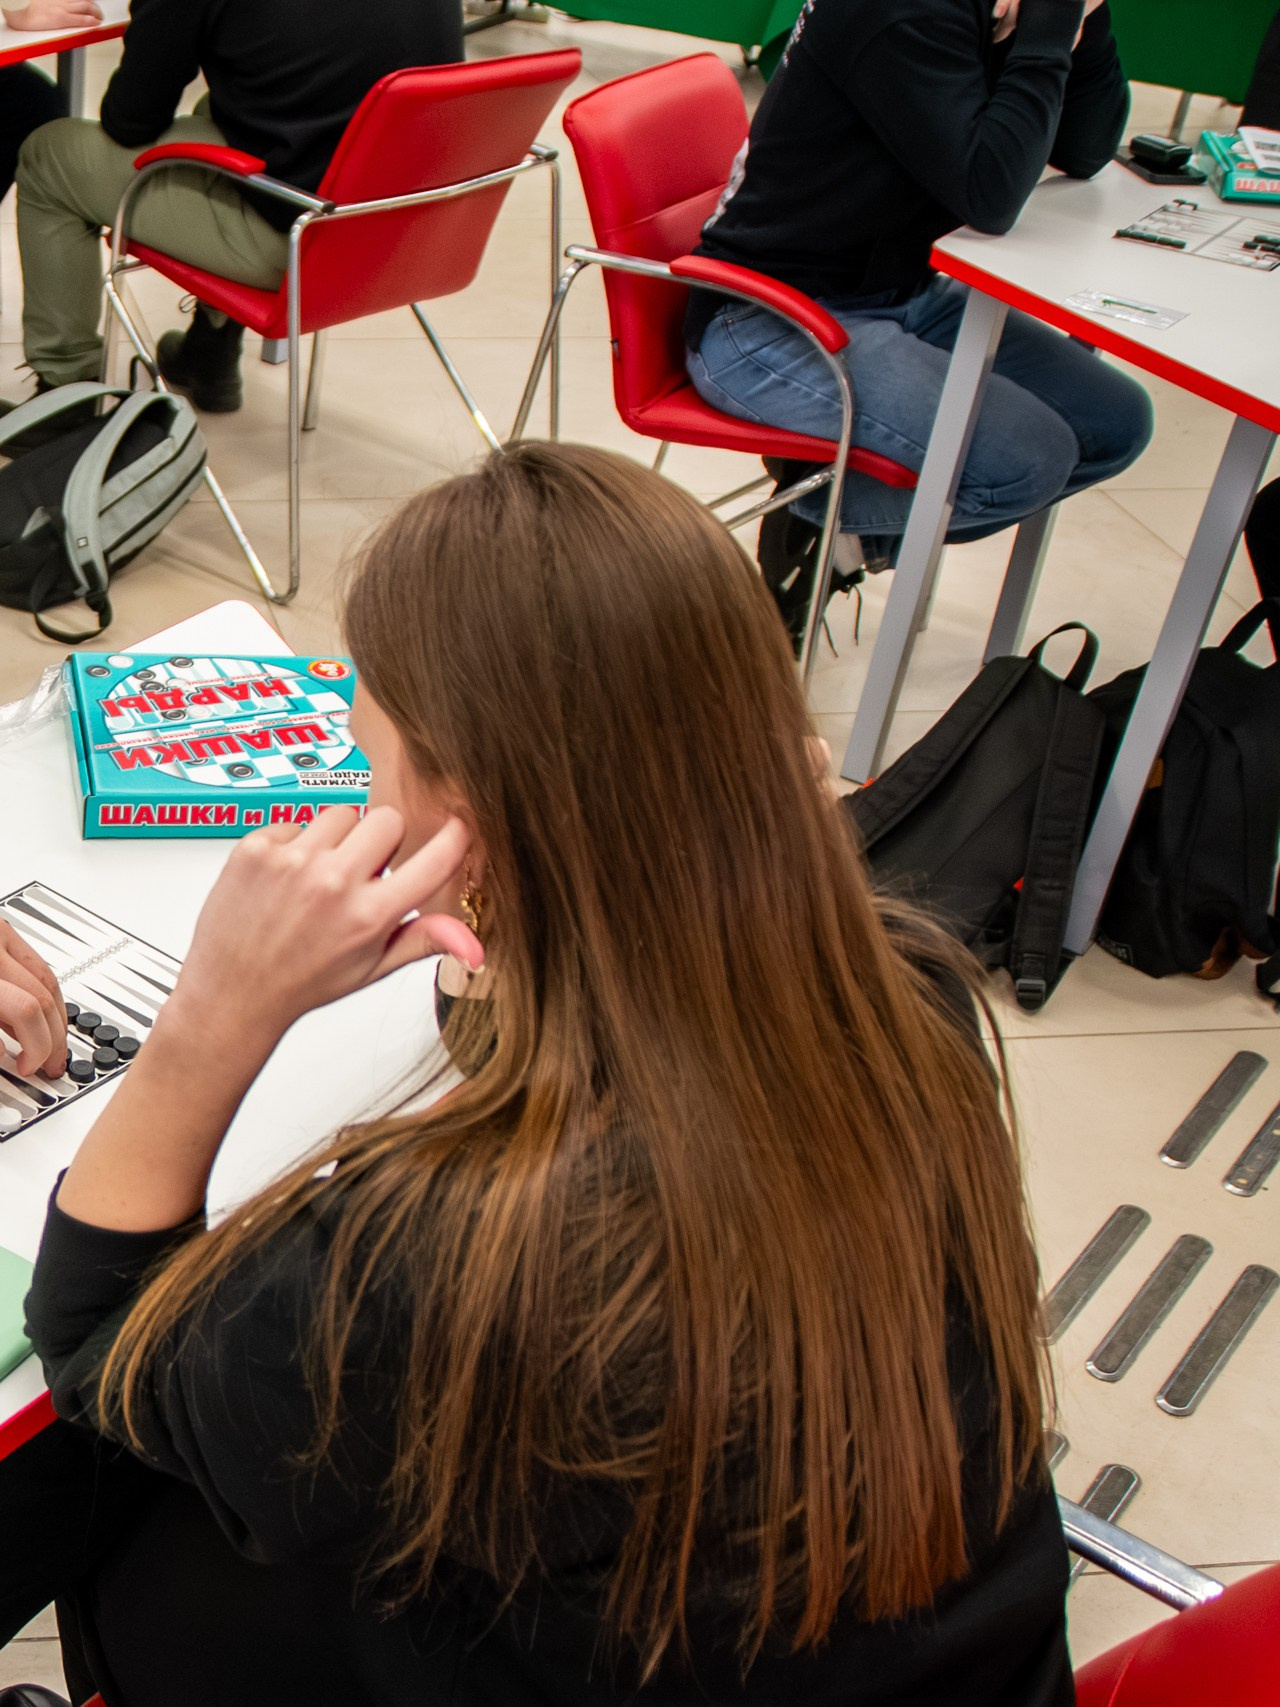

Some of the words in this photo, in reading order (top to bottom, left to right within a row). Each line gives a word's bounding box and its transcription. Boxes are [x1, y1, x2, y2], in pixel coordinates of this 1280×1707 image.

[98, 677, 295, 718] НАРДЫ
[109, 721, 331, 771] ШАШКИ
[301, 778, 357, 786] ДУМАТЬ
[99, 803, 237, 827] ШАШКИ
[243, 809, 264, 826] и
